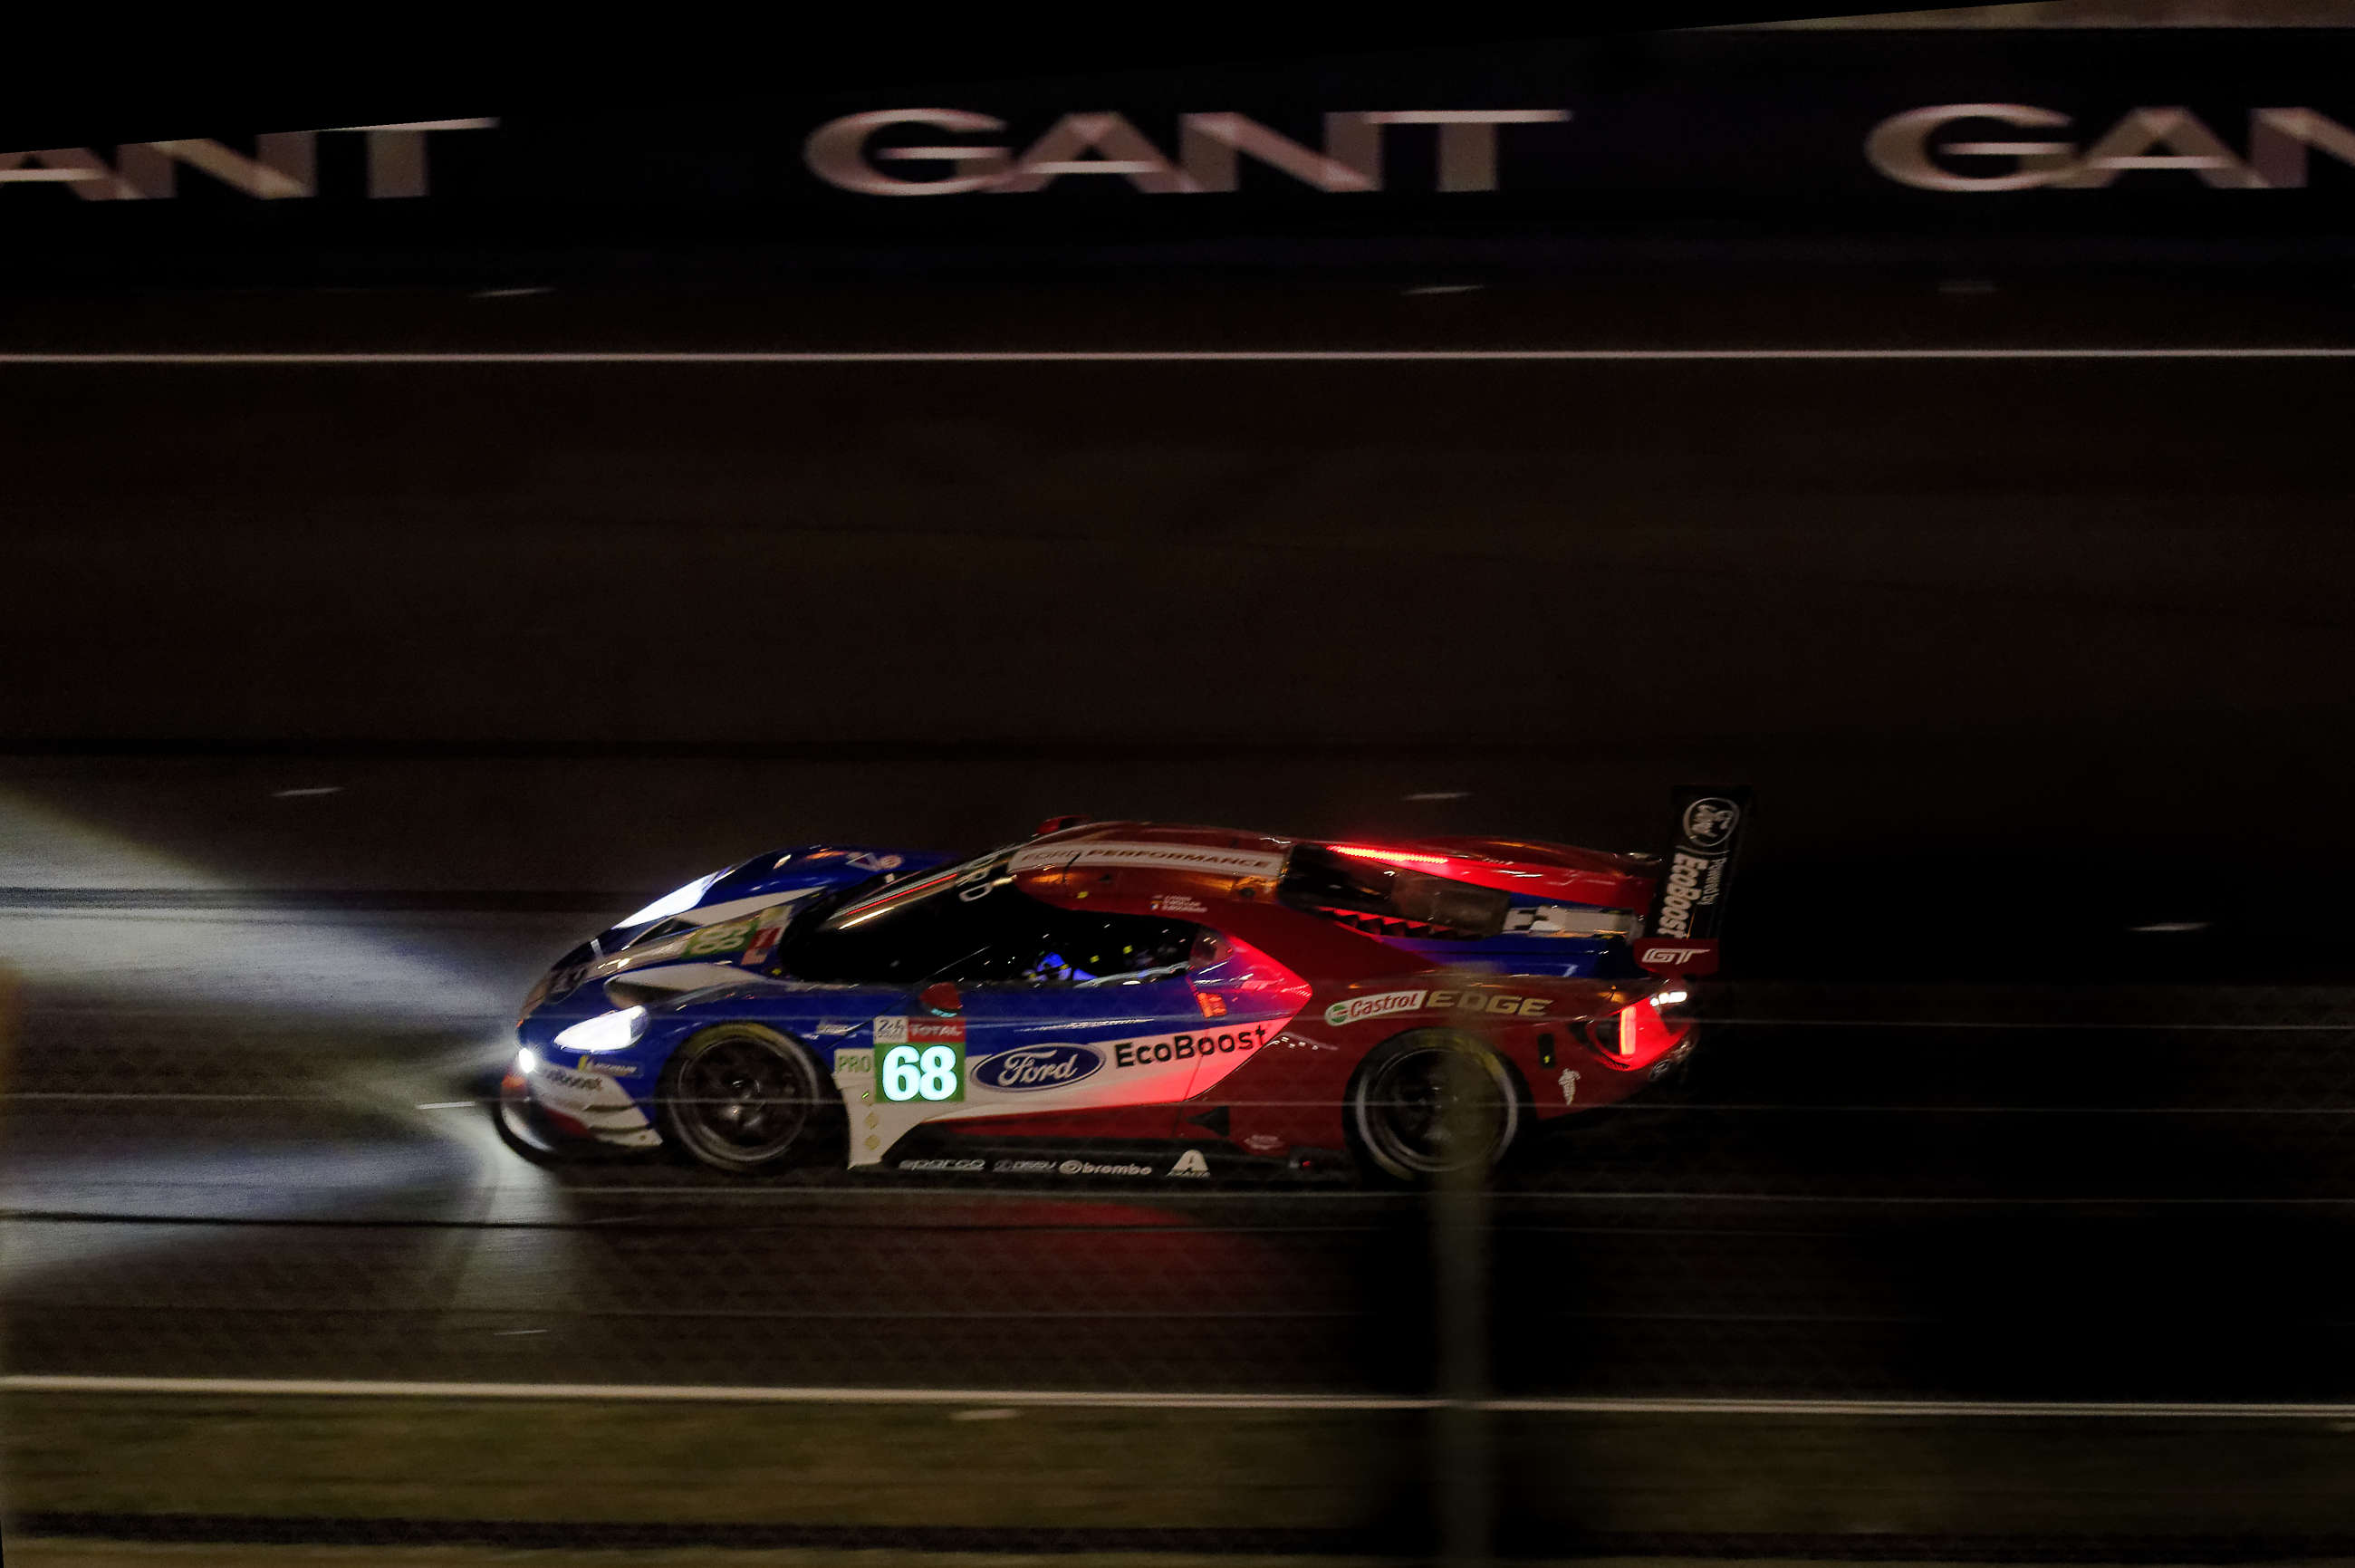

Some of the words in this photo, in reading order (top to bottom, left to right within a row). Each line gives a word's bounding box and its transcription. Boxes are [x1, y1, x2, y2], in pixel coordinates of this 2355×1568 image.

[802, 107, 1574, 197] GANT
[1086, 848, 1271, 869] PERFORMANCE
[1641, 948, 1711, 965] GT
[1351, 993, 1419, 1018] Castrol
[1426, 991, 1555, 1016] EDGE
[909, 1023, 963, 1036] TOTAL
[1114, 1024, 1267, 1068] EcoBoost
[839, 1055, 872, 1073] PRO
[882, 1044, 957, 1101] 68
[997, 1049, 1078, 1087] Ford
[1081, 1162, 1153, 1176] brembo
